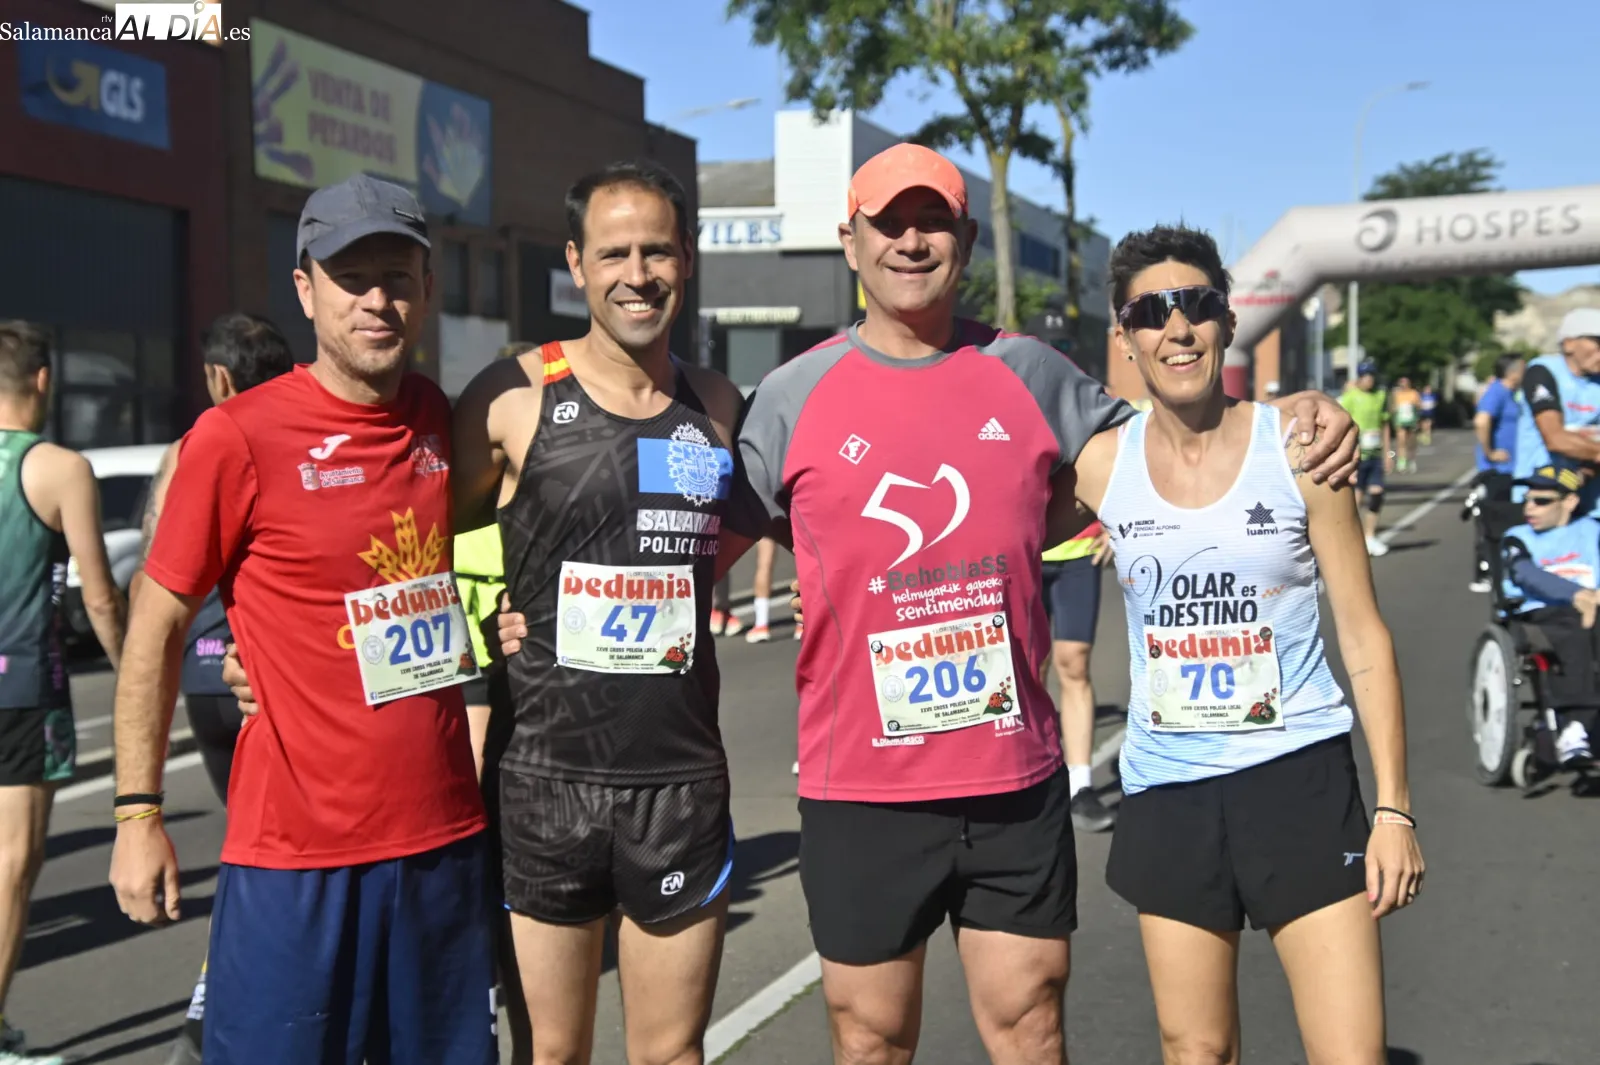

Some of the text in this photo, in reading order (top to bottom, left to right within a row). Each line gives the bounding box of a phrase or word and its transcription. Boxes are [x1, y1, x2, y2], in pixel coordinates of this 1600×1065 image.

[101, 68, 144, 123] GLS
[1417, 204, 1582, 245] HOSPES
[978, 432, 1011, 441] adidas
[1246, 526, 1279, 536] luanvi
[895, 590, 1004, 621] sentimendua
[1241, 584, 1257, 598] es
[601, 605, 657, 643] 47
[1144, 599, 1258, 628] mi DESTINO
[384, 612, 452, 666] 207
[905, 655, 987, 705] 206
[1180, 663, 1236, 701] 70
